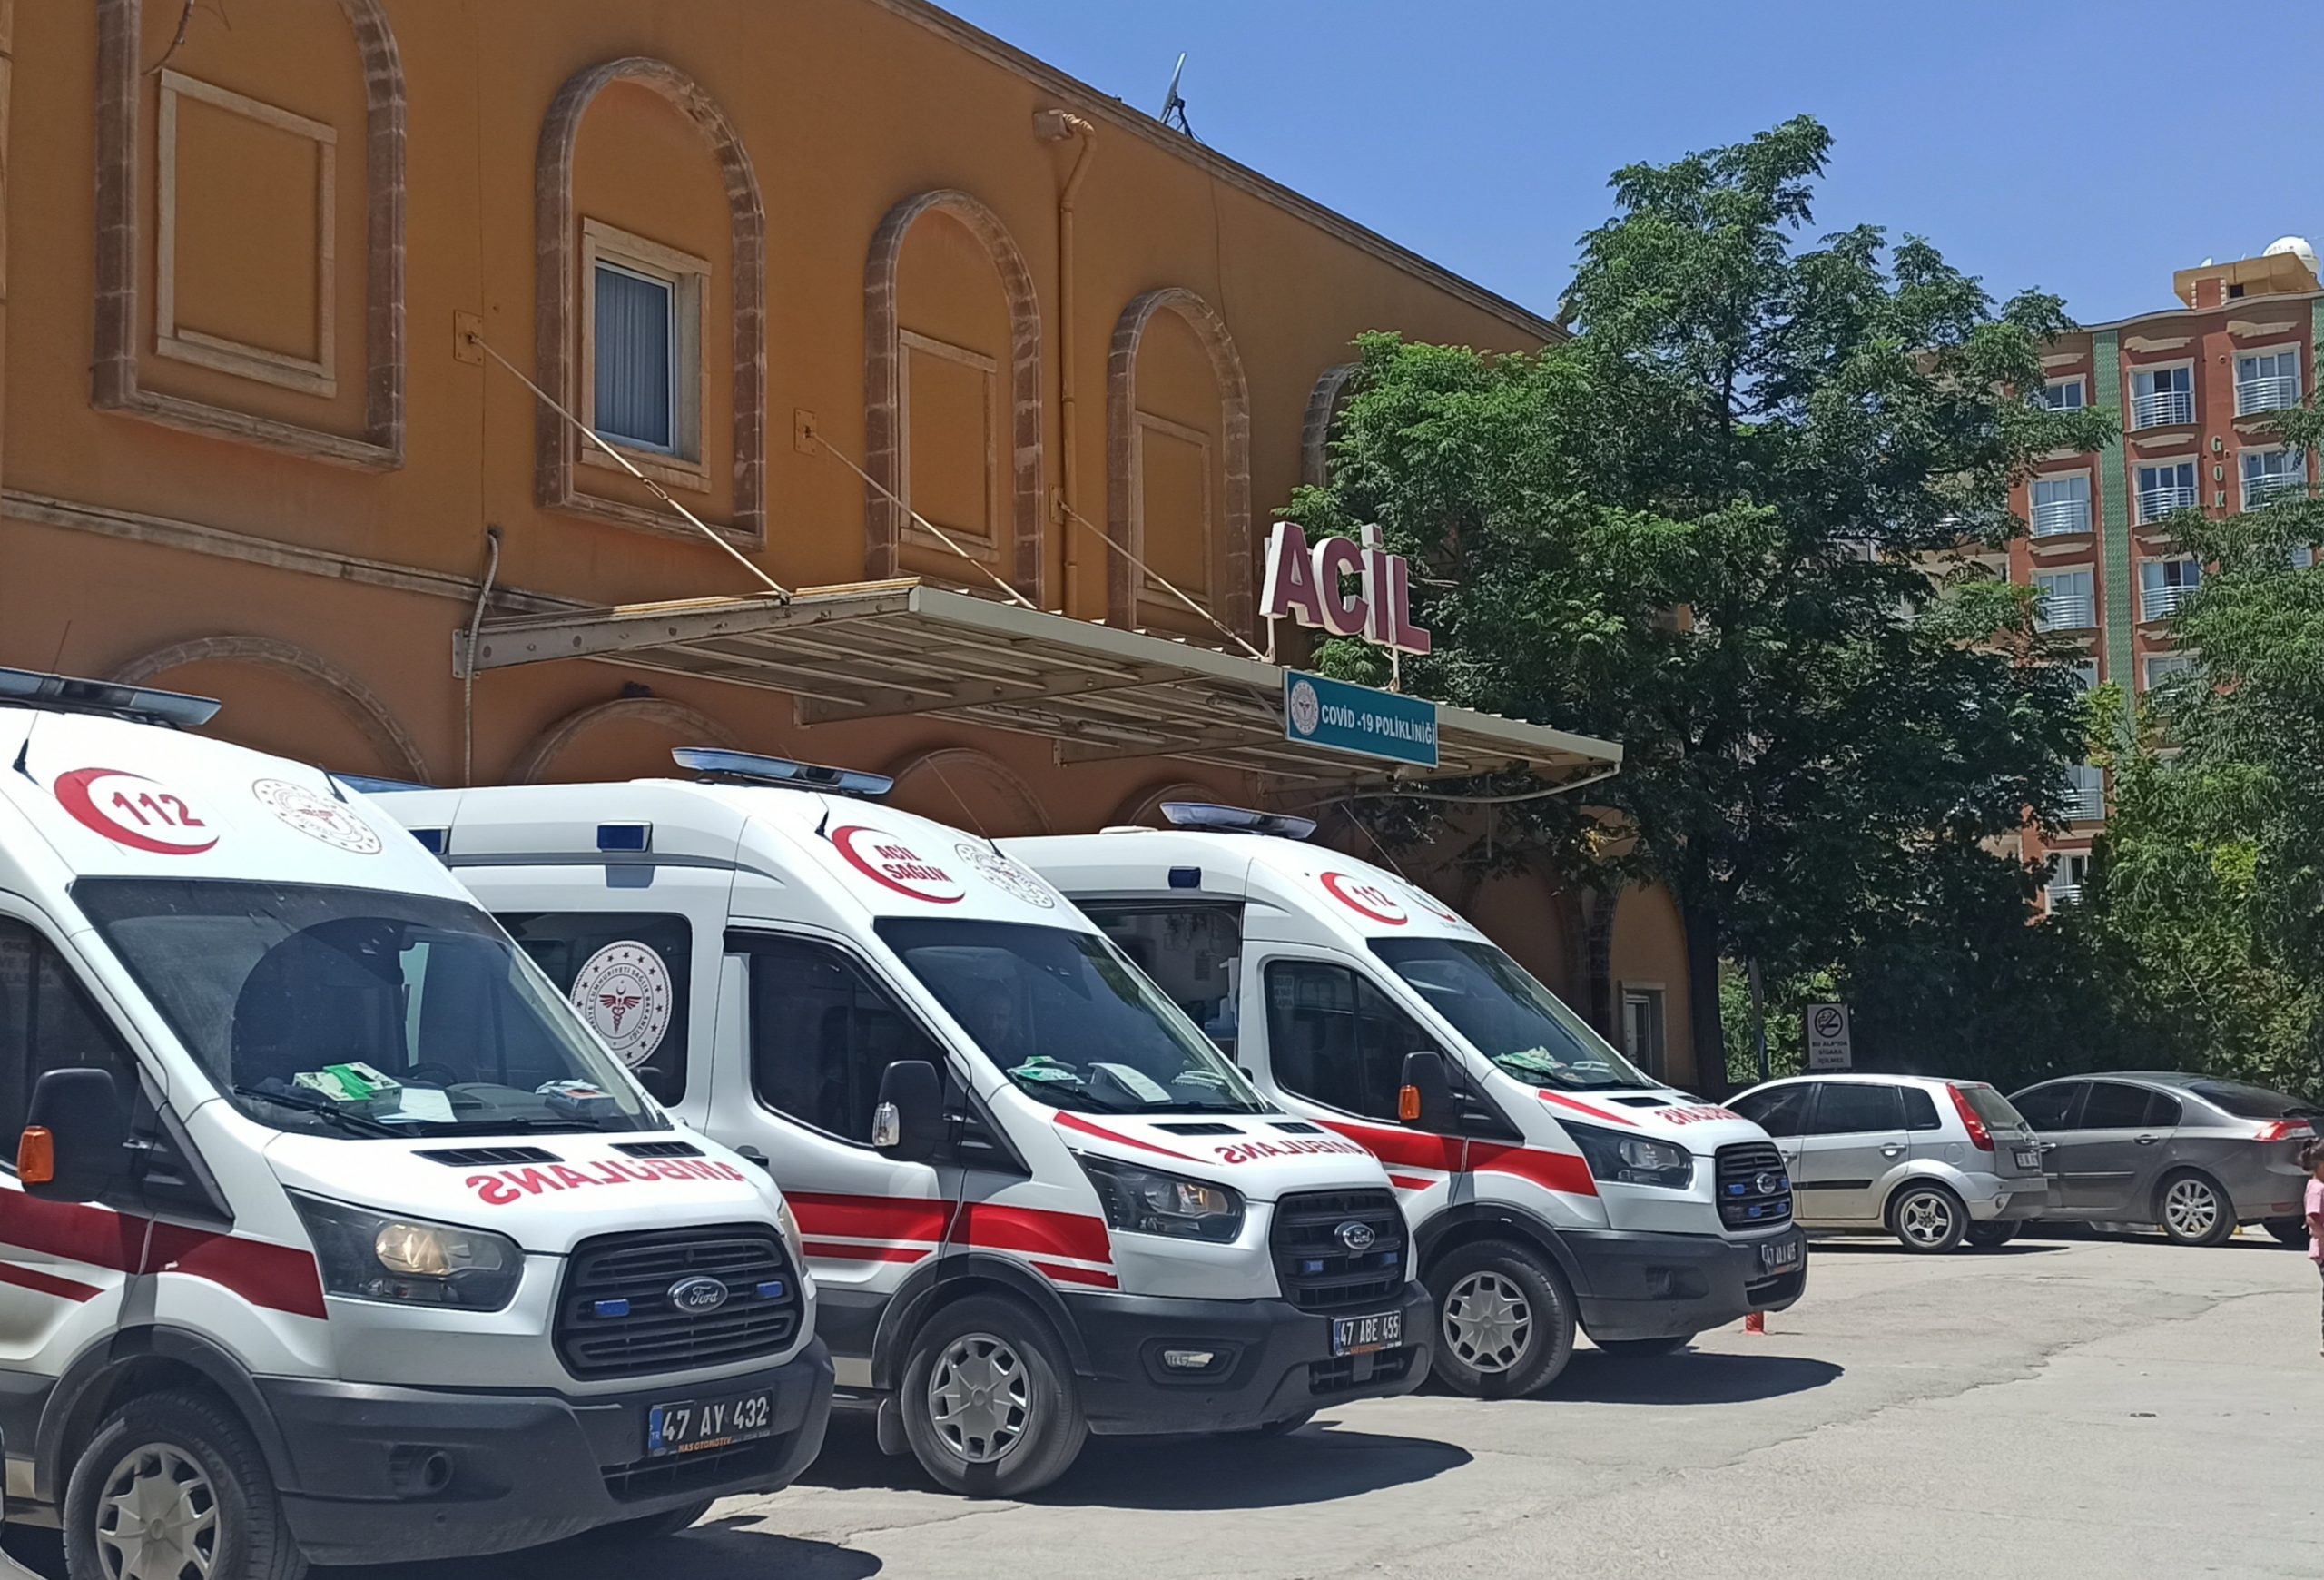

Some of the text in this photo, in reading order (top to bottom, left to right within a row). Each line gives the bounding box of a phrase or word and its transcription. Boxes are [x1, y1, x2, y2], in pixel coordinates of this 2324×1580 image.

[1259, 521, 1431, 655] ACİL
[1321, 705, 1355, 729] COVİD
[1375, 715, 1435, 745] POLİKLİNİĞİ
[112, 791, 206, 826] 112
[873, 844, 922, 862] ACİL
[881, 862, 955, 884] SAĞLIK
[1351, 885, 1397, 906] 112
[690, 1285, 719, 1306] Ford
[1340, 1316, 1399, 1346] 47 ABE 455
[662, 1397, 768, 1442] 47 AY 432
